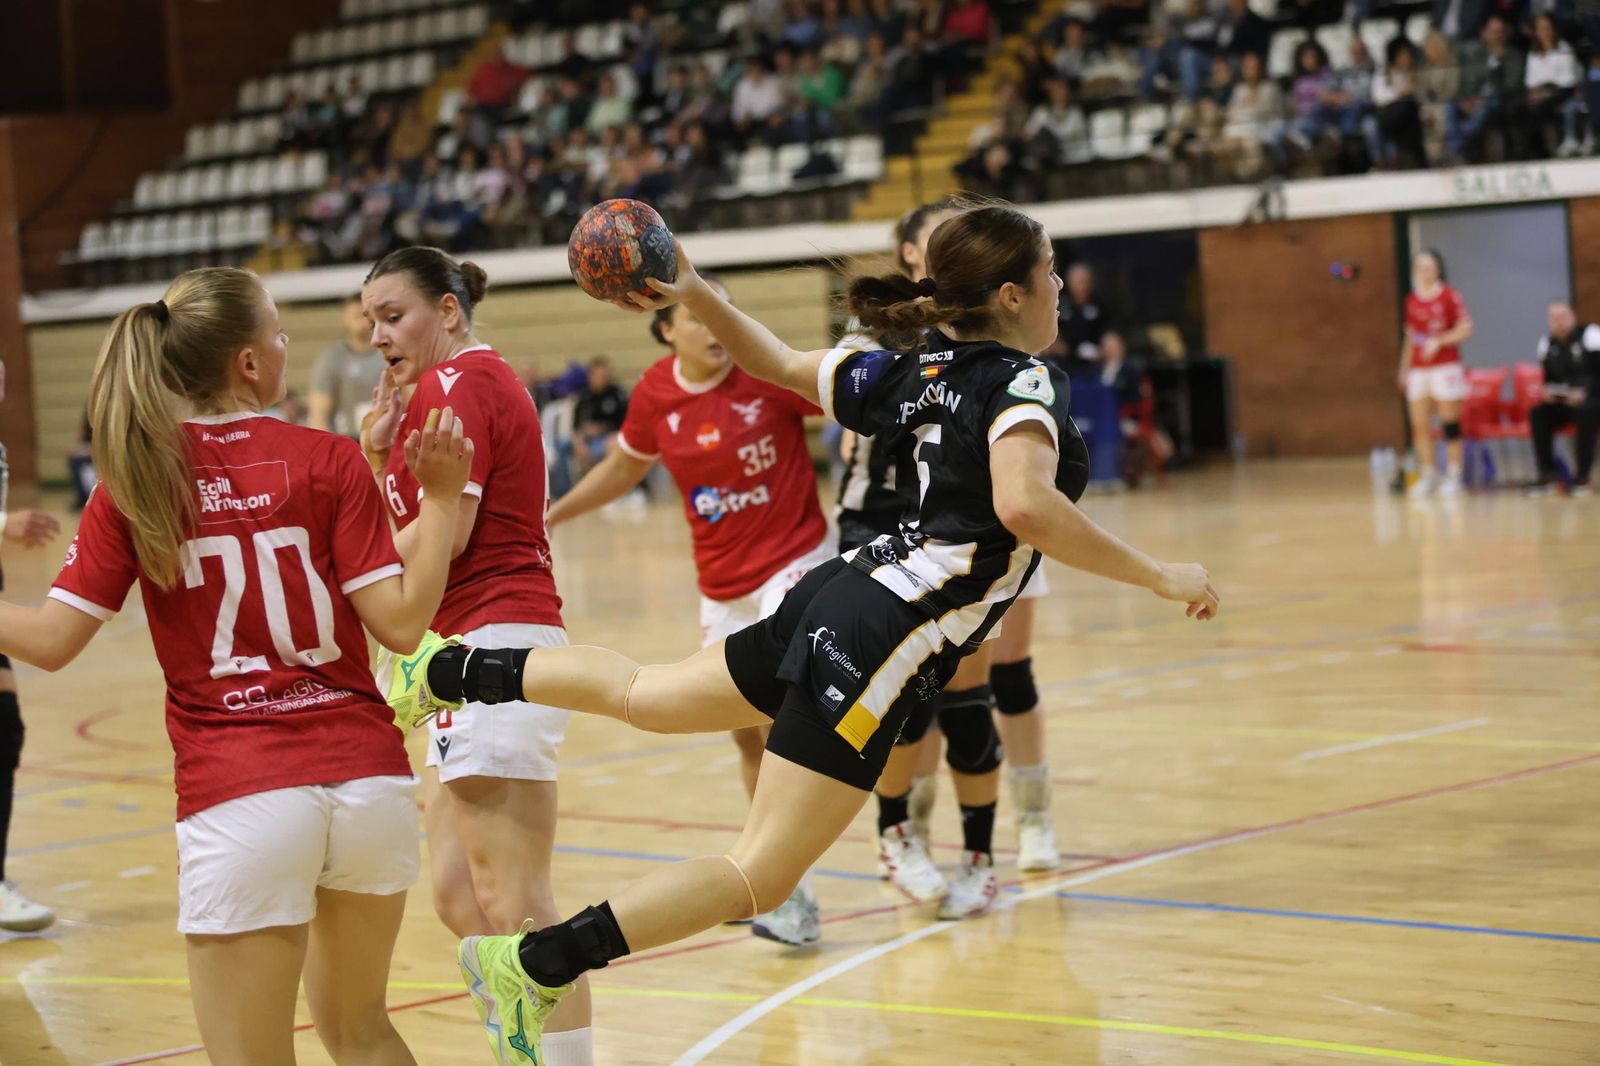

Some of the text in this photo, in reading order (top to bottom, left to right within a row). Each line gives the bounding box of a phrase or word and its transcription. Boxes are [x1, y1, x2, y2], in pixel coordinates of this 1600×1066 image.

[1452, 168, 1553, 200] SALIDA
[737, 435, 778, 477] 35
[196, 476, 232, 500] Egill
[179, 526, 342, 680] 20
[821, 640, 863, 680] frigiliana
[223, 685, 269, 711] CG
